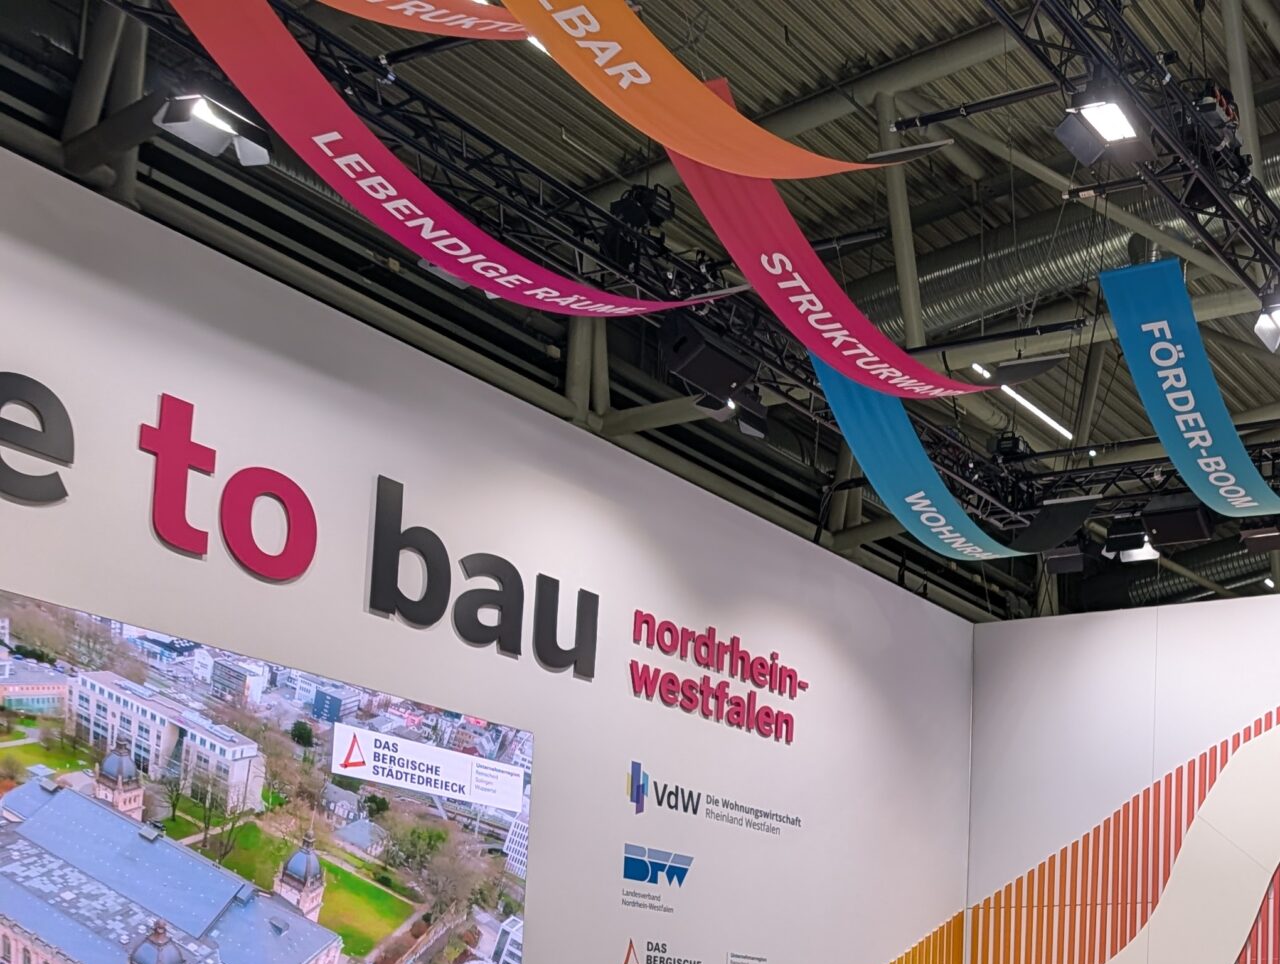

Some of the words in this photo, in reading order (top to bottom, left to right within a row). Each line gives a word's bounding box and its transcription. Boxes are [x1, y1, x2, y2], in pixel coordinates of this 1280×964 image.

[538, 0, 651, 89] BAR
[312, 131, 533, 289] LEBENDIGE
[523, 287, 647, 314] RÄUME
[1141, 320, 1259, 509] FÖRDER-BOOM
[139, 393, 317, 583] to
[367, 474, 599, 681] bau
[633, 609, 809, 699] nordrhein-
[630, 659, 795, 745] westfalen
[374, 738, 398, 753] DAS
[372, 765, 466, 795] STÄDTEDREIECK
[373, 751, 440, 777] BERGISCHE
[653, 780, 701, 815] VdW
[706, 795, 720, 807] Die
[722, 798, 802, 828] Wohnungswirtschaft
[706, 808, 743, 827] Rheinland
[745, 817, 781, 836] Westfalen
[646, 941, 667, 954] DAS
